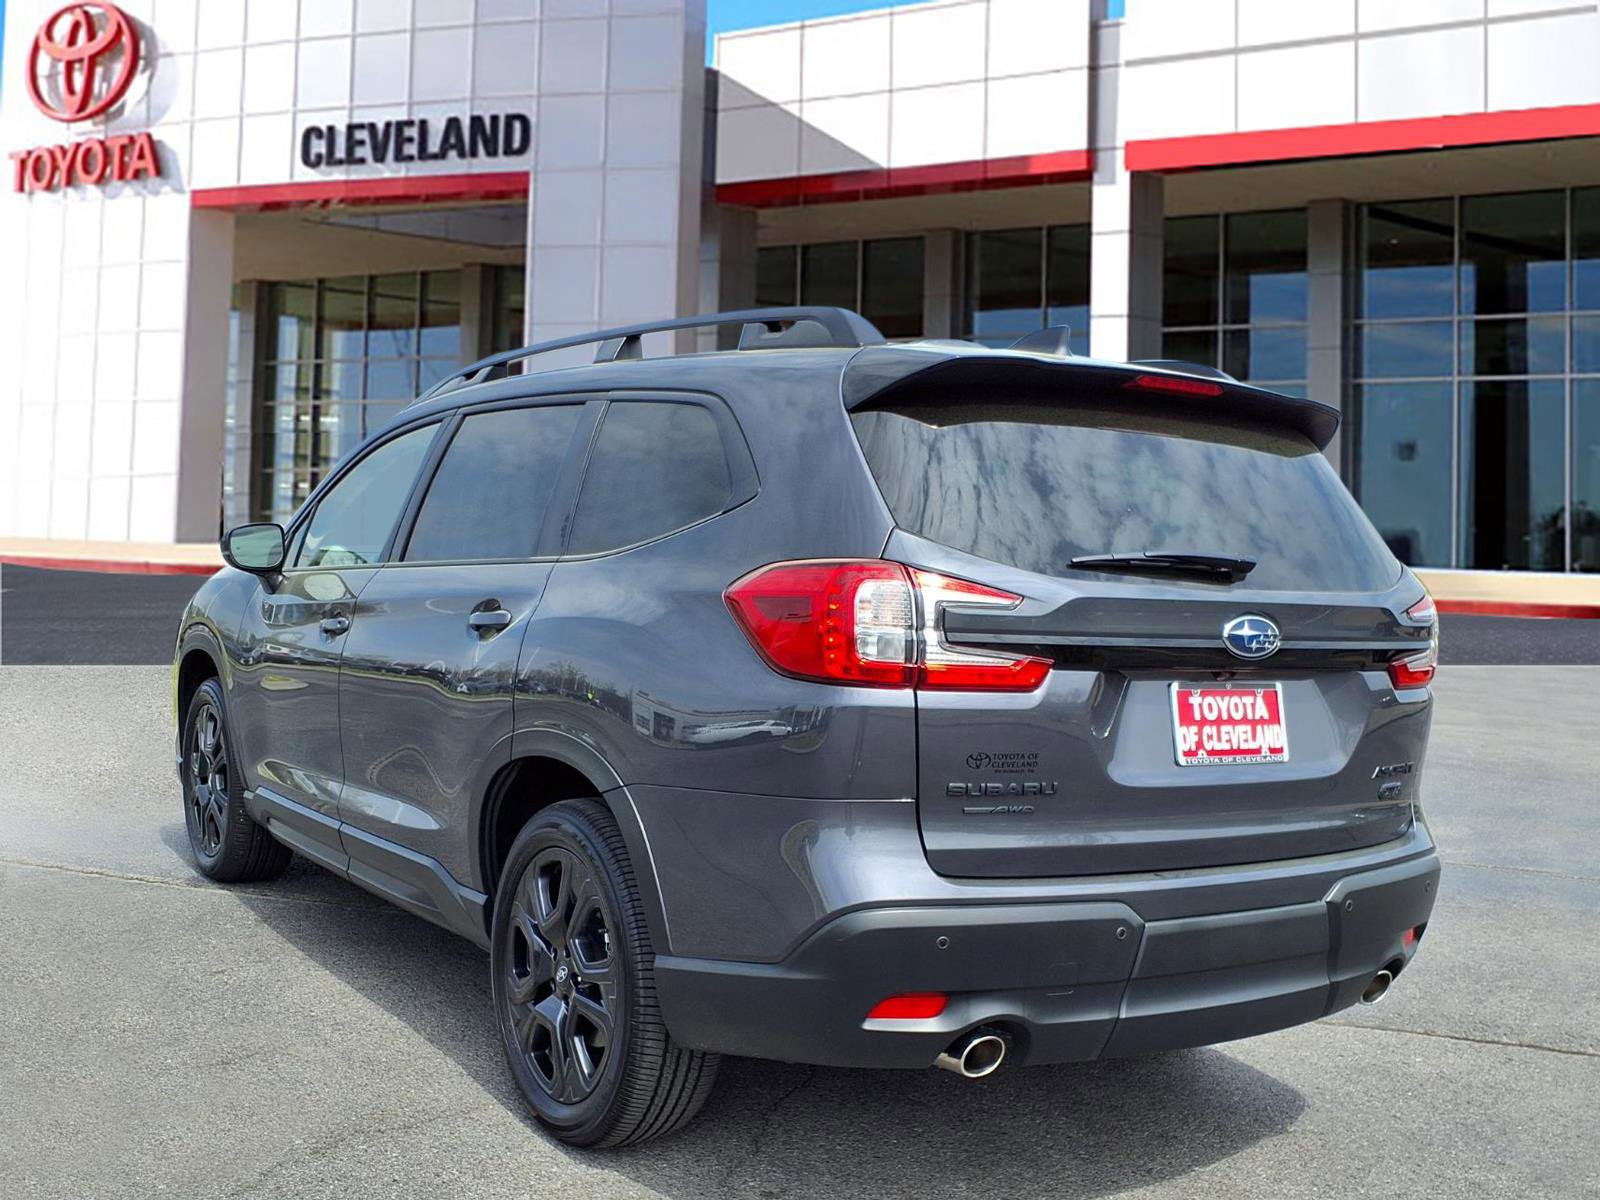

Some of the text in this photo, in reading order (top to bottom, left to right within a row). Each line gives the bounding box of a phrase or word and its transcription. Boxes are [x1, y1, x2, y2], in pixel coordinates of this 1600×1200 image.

[301, 113, 531, 169] CLEVELAND
[9, 132, 159, 193] TOYOTA
[1189, 695, 1269, 720] TOYOTA
[1180, 724, 1284, 751] OF CLEVELAND
[993, 752, 1039, 760] TOYOTA OF
[1236, 755, 1283, 763] CLEVELAND
[991, 761, 1039, 769] CLEVELAND
[946, 782, 1058, 797] SUBARU
[992, 805, 1034, 814] AWD
